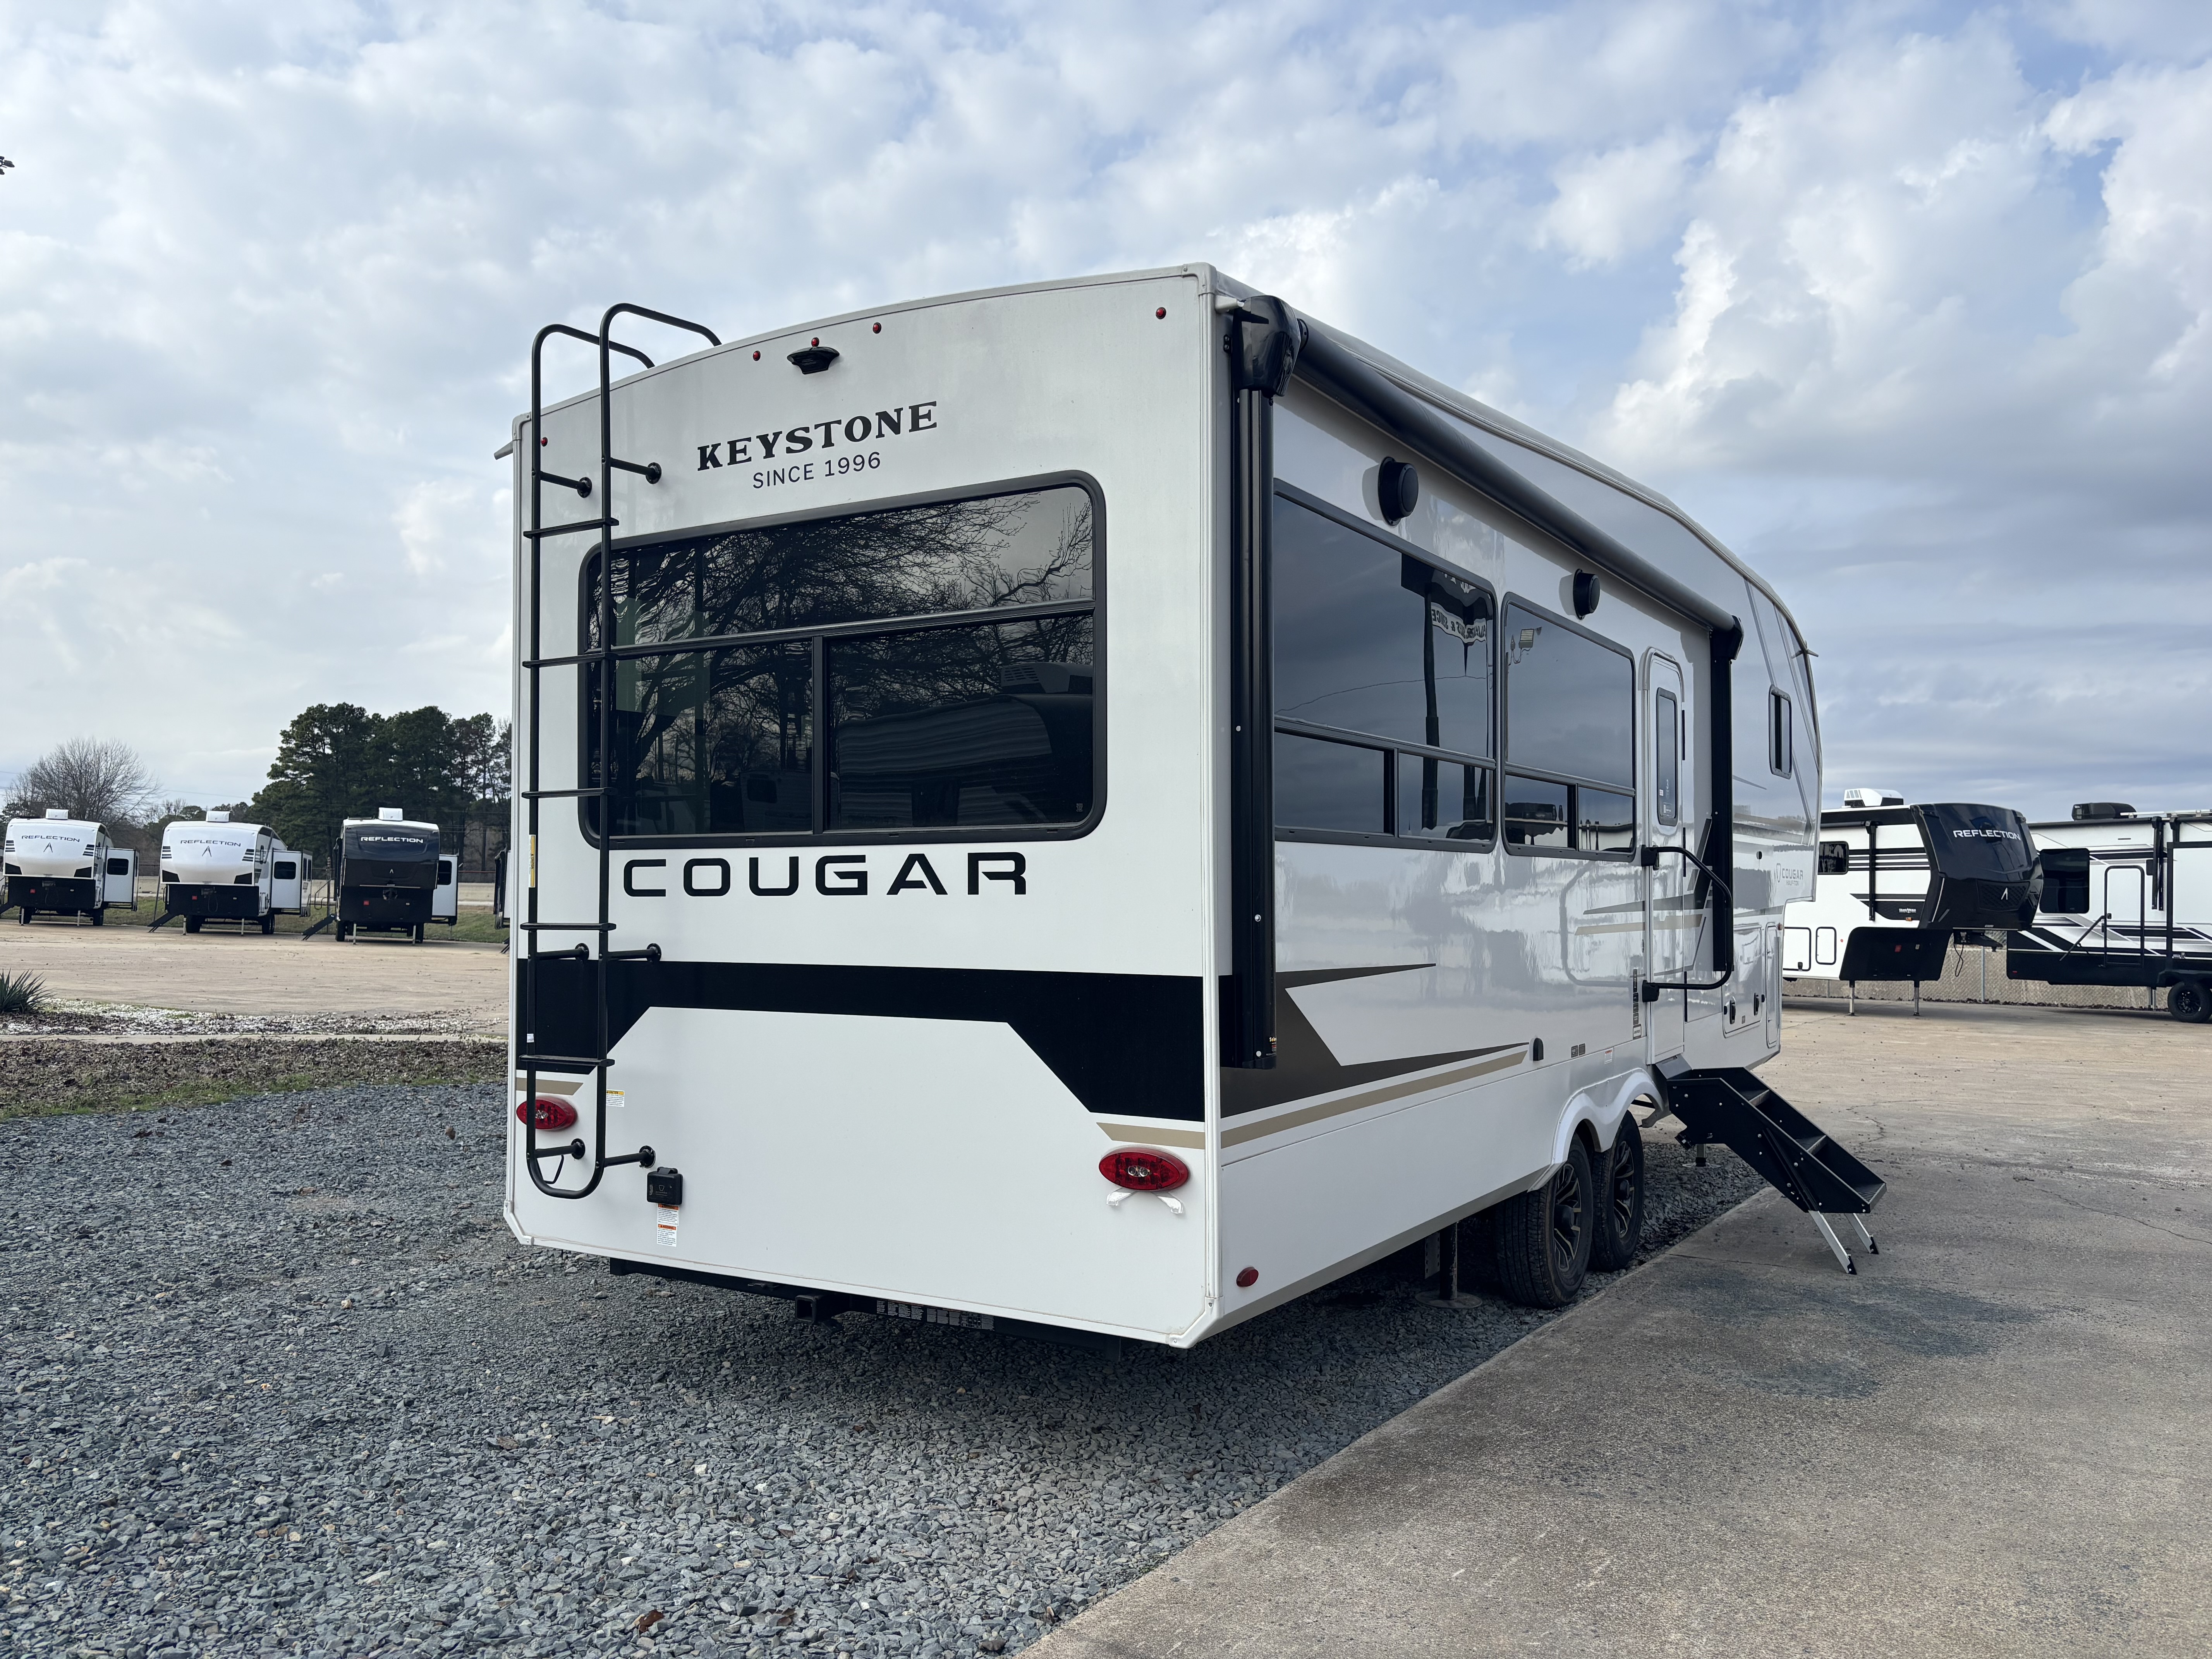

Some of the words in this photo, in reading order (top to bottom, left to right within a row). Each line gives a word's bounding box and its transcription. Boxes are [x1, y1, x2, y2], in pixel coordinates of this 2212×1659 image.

[697, 401, 937, 471] KEYSTONE
[753, 463, 814, 489] SINCE
[825, 452, 881, 477] 1996
[1953, 830, 2021, 841] REFLECTION
[623, 852, 1026, 897] COUGAR
[1782, 868, 1803, 880] COUGAR
